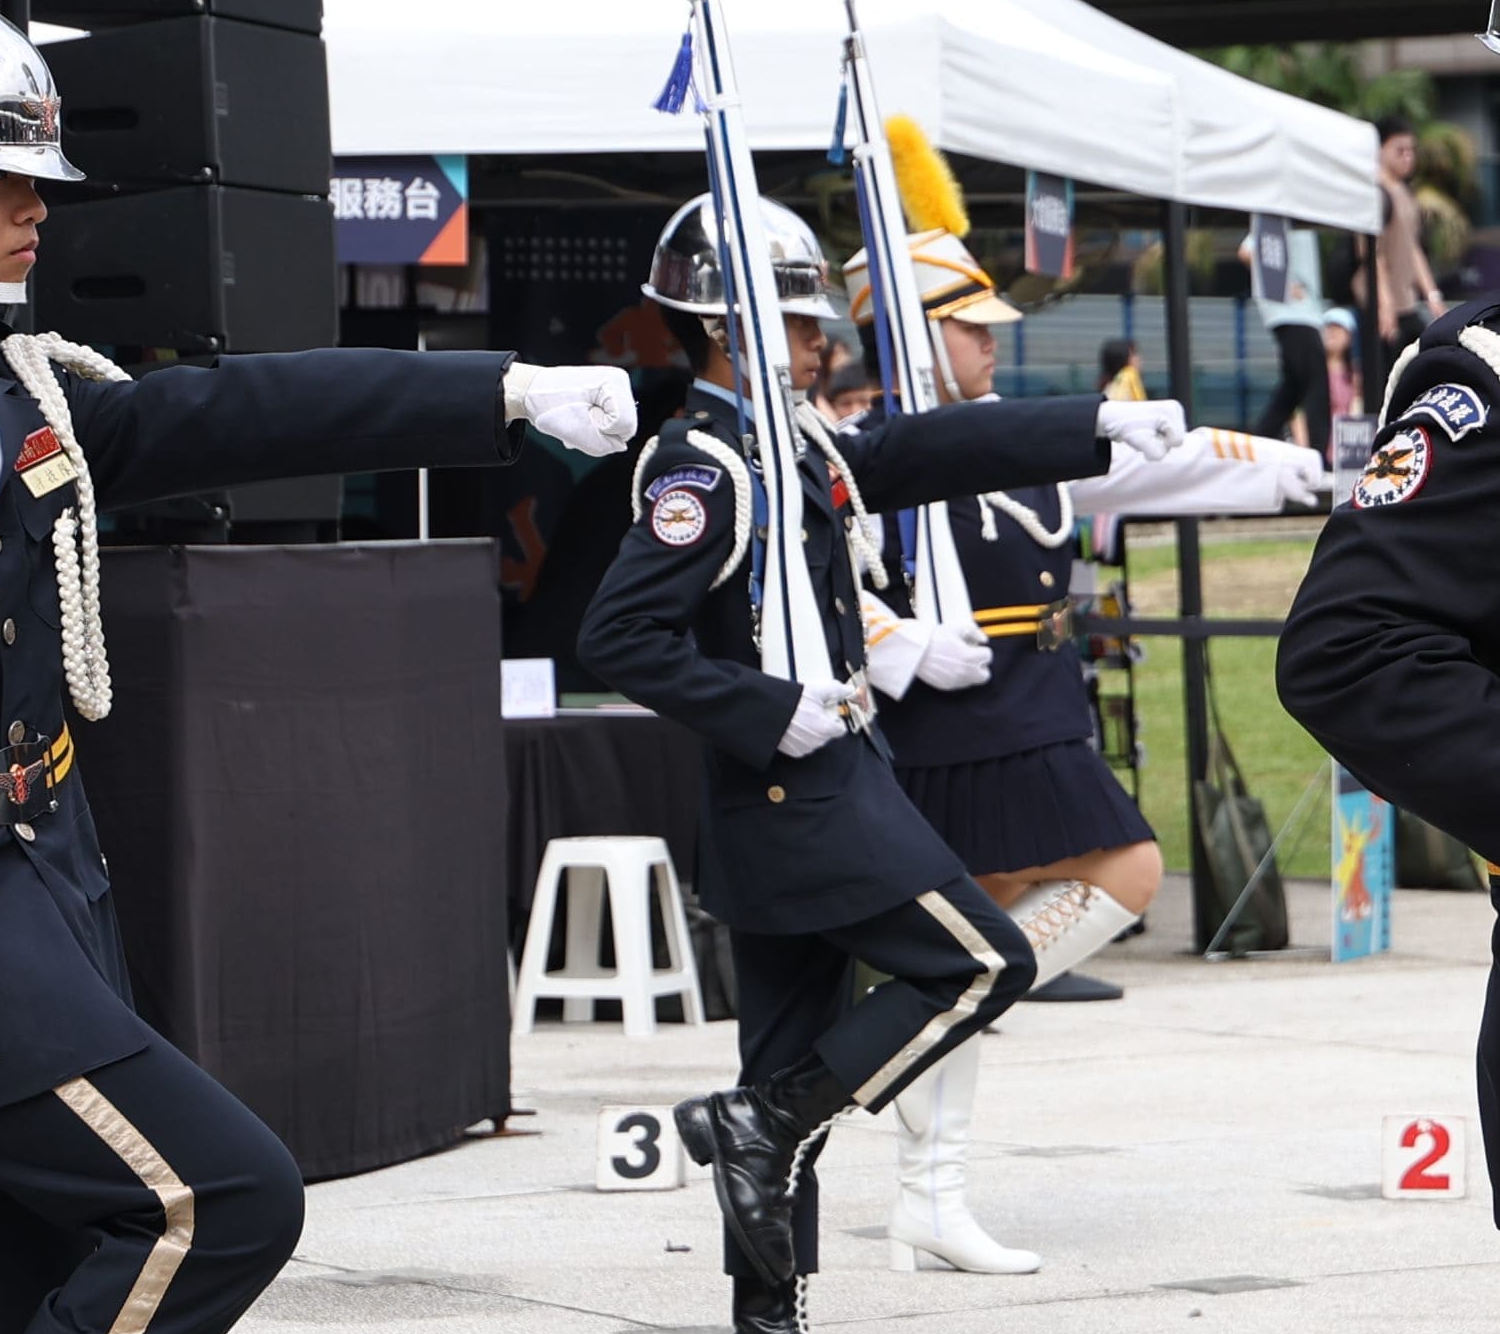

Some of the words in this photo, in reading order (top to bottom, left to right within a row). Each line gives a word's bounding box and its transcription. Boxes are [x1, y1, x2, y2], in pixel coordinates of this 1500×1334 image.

[327, 176, 441, 220] 服務台
[611, 1113, 662, 1180] 3
[1398, 1120, 1452, 1191] 2
